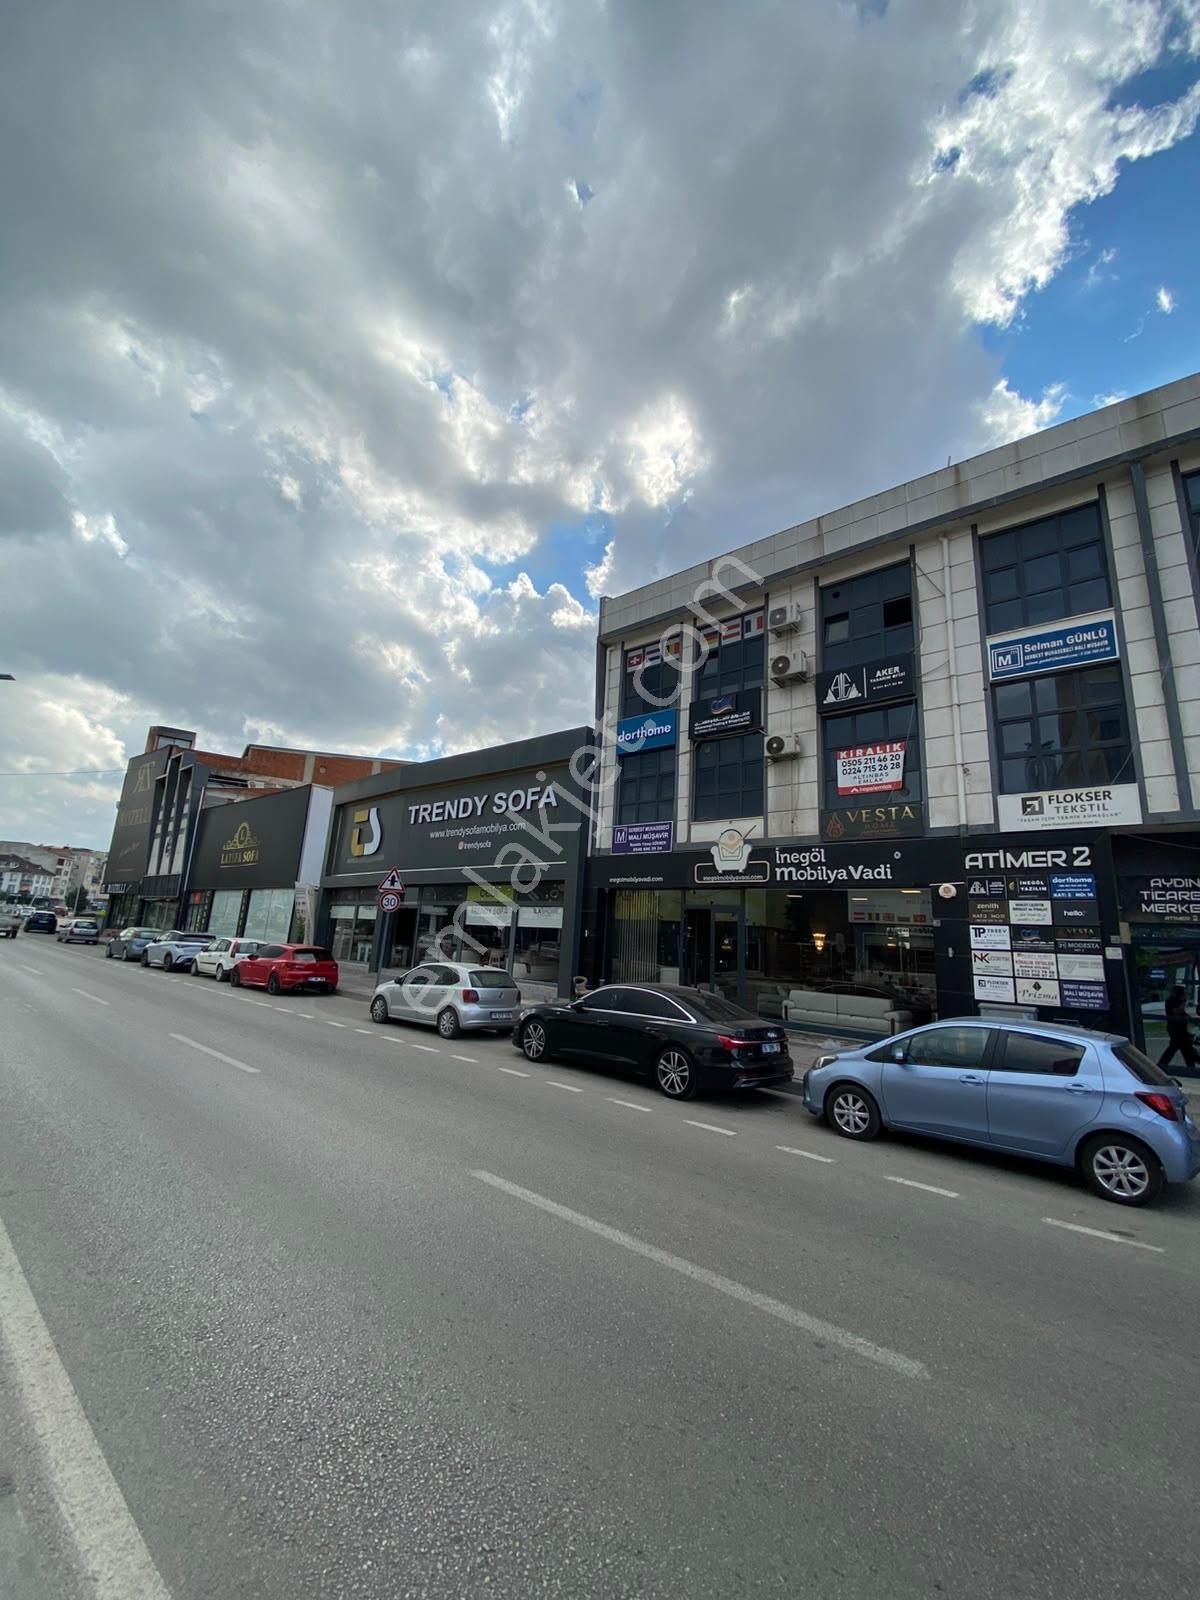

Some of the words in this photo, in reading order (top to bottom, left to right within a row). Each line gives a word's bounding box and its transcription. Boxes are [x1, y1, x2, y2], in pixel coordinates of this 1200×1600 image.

[1024, 640, 1064, 653] Selman
[1066, 628, 1108, 644] GÜNLÜ
[876, 666, 899, 677] AKER
[618, 724, 672, 742] dorthome
[877, 755, 888, 763] 46
[842, 767, 861, 776] 0224
[864, 765, 876, 773] 715
[878, 763, 888, 771] 26
[1048, 790, 1112, 804] FLOKSER
[408, 795, 488, 824] TRENDY
[492, 786, 558, 814] SOFA
[1054, 803, 1108, 814] TEKSTİL
[846, 806, 915, 823] VESTA
[430, 822, 526, 839] www.trendysofamobilya.com
[965, 849, 1068, 869] ATİMER
[1072, 846, 1092, 866] 2
[384, 898, 396, 907] 30
